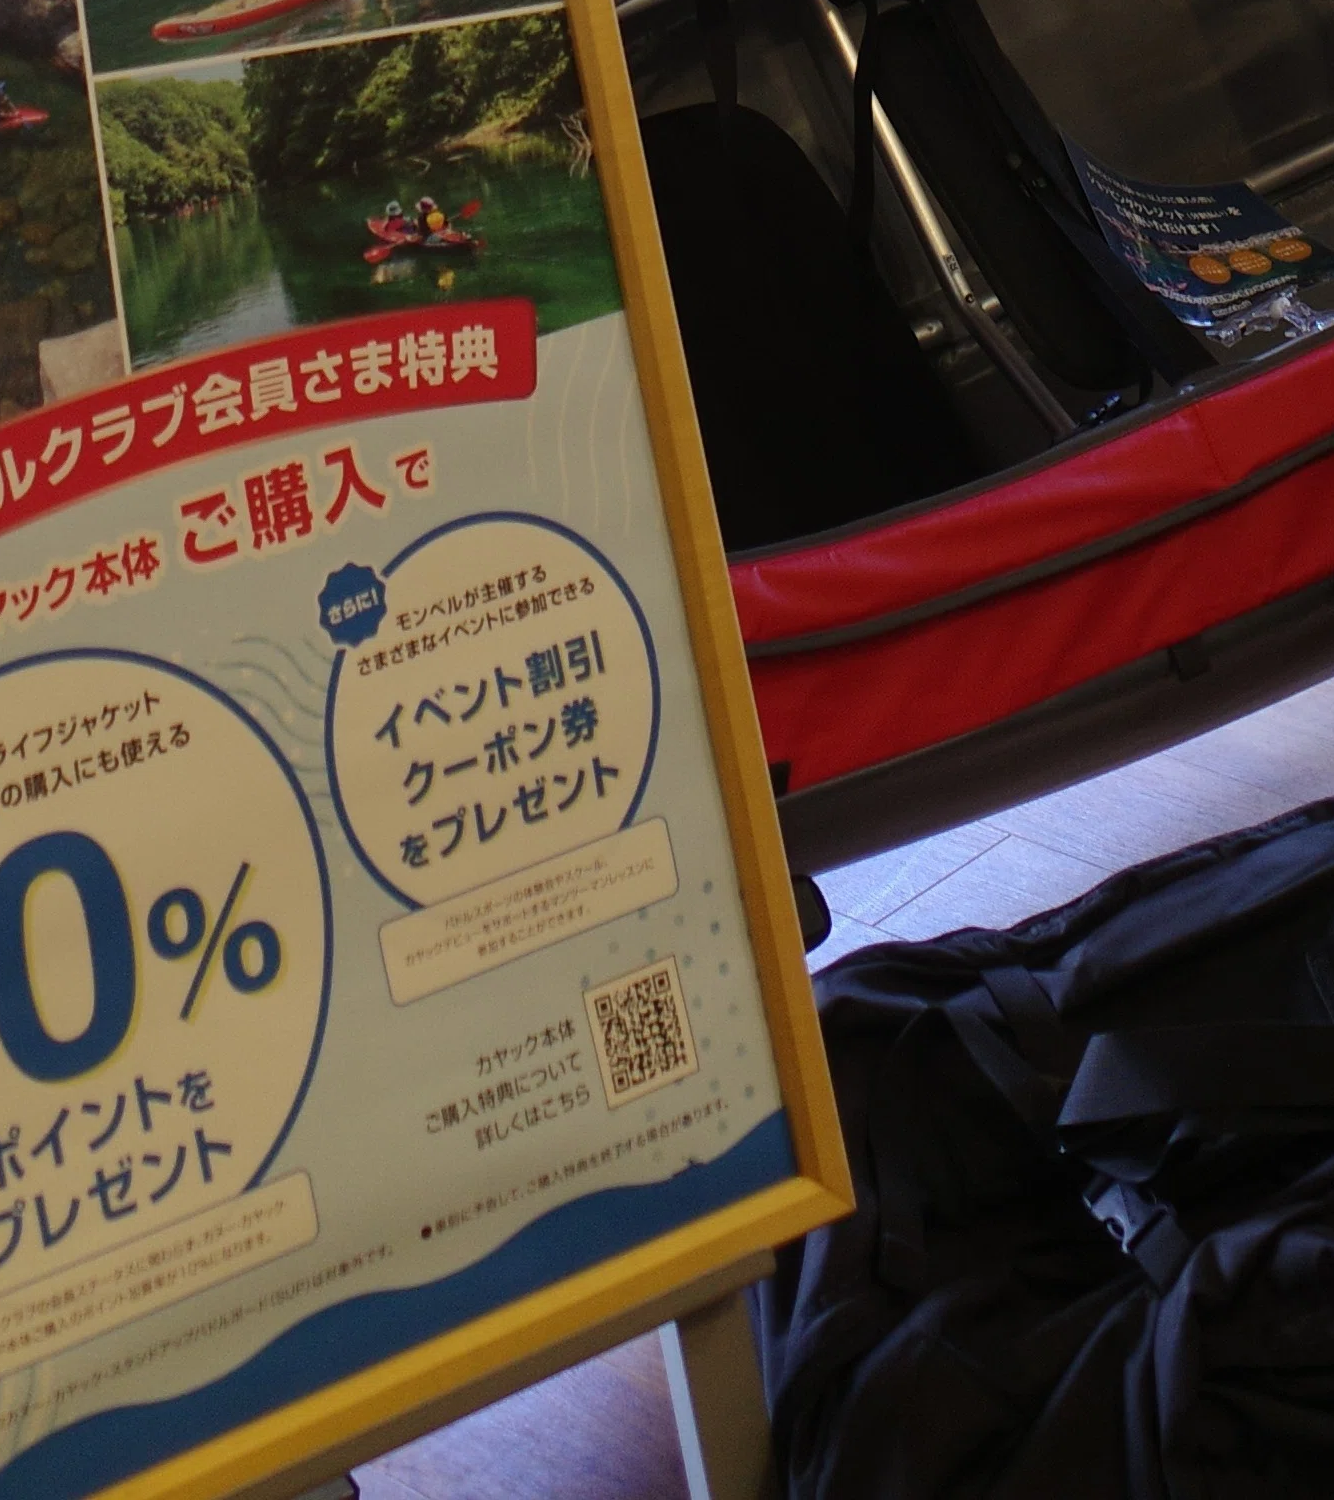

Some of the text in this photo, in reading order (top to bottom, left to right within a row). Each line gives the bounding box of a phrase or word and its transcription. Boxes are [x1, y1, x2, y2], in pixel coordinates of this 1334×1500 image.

[180, 447, 387, 566] ご購入
[327, 590, 379, 625] さらに!
[357, 576, 595, 676] さまざまなイベントに参加できる
[395, 564, 547, 631] モンベルが主催する
[375, 630, 606, 749] イベント割引
[403, 696, 599, 807] クーポン券
[400, 756, 620, 869] をプレゼント
[424, 1052, 583, 1134] ご購入特典について
[475, 1018, 575, 1077] カヤック本体
[474, 1084, 590, 1151] 詳しくはこちら
